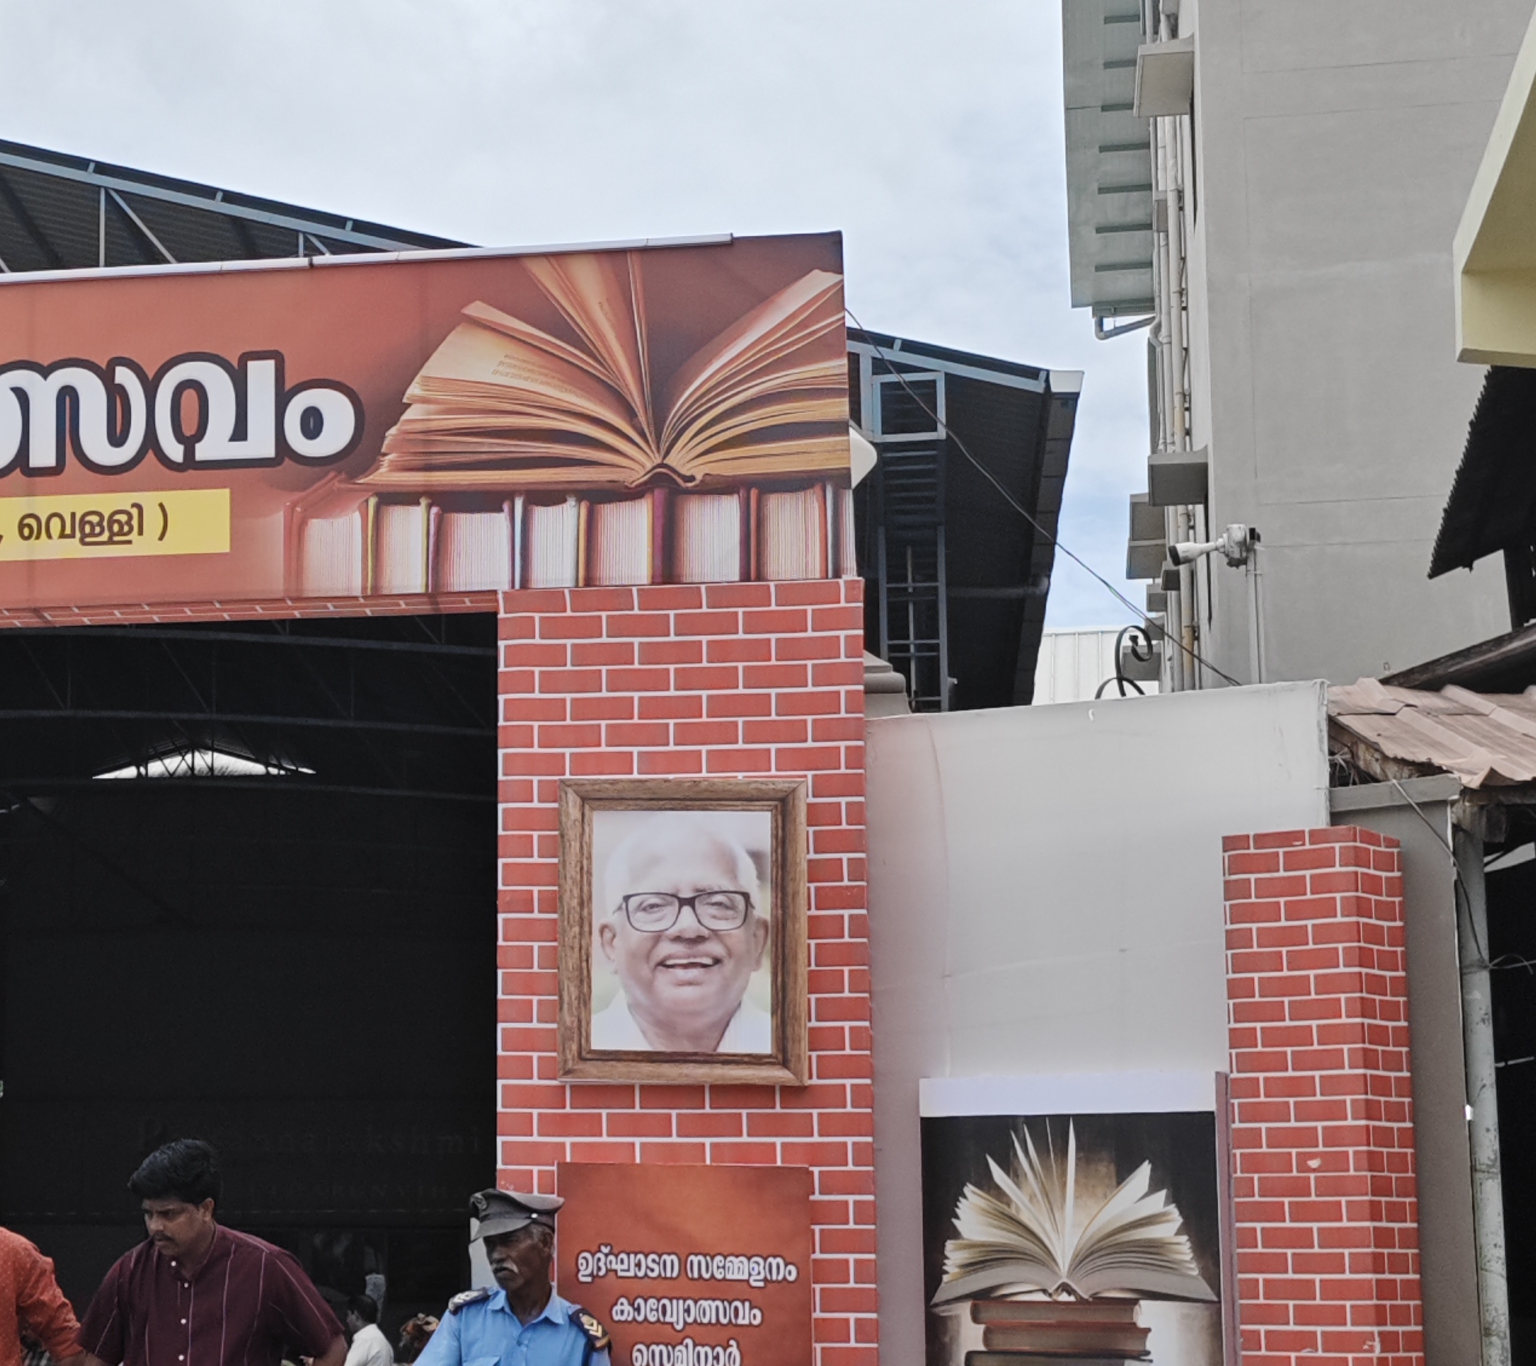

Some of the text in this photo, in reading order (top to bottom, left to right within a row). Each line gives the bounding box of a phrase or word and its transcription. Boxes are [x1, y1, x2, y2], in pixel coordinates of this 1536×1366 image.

[577, 1244, 798, 1287] ഉദ്ഘാടന സമ്മേളനം
[611, 1296, 763, 1331] കാവ്യോത്സവം
